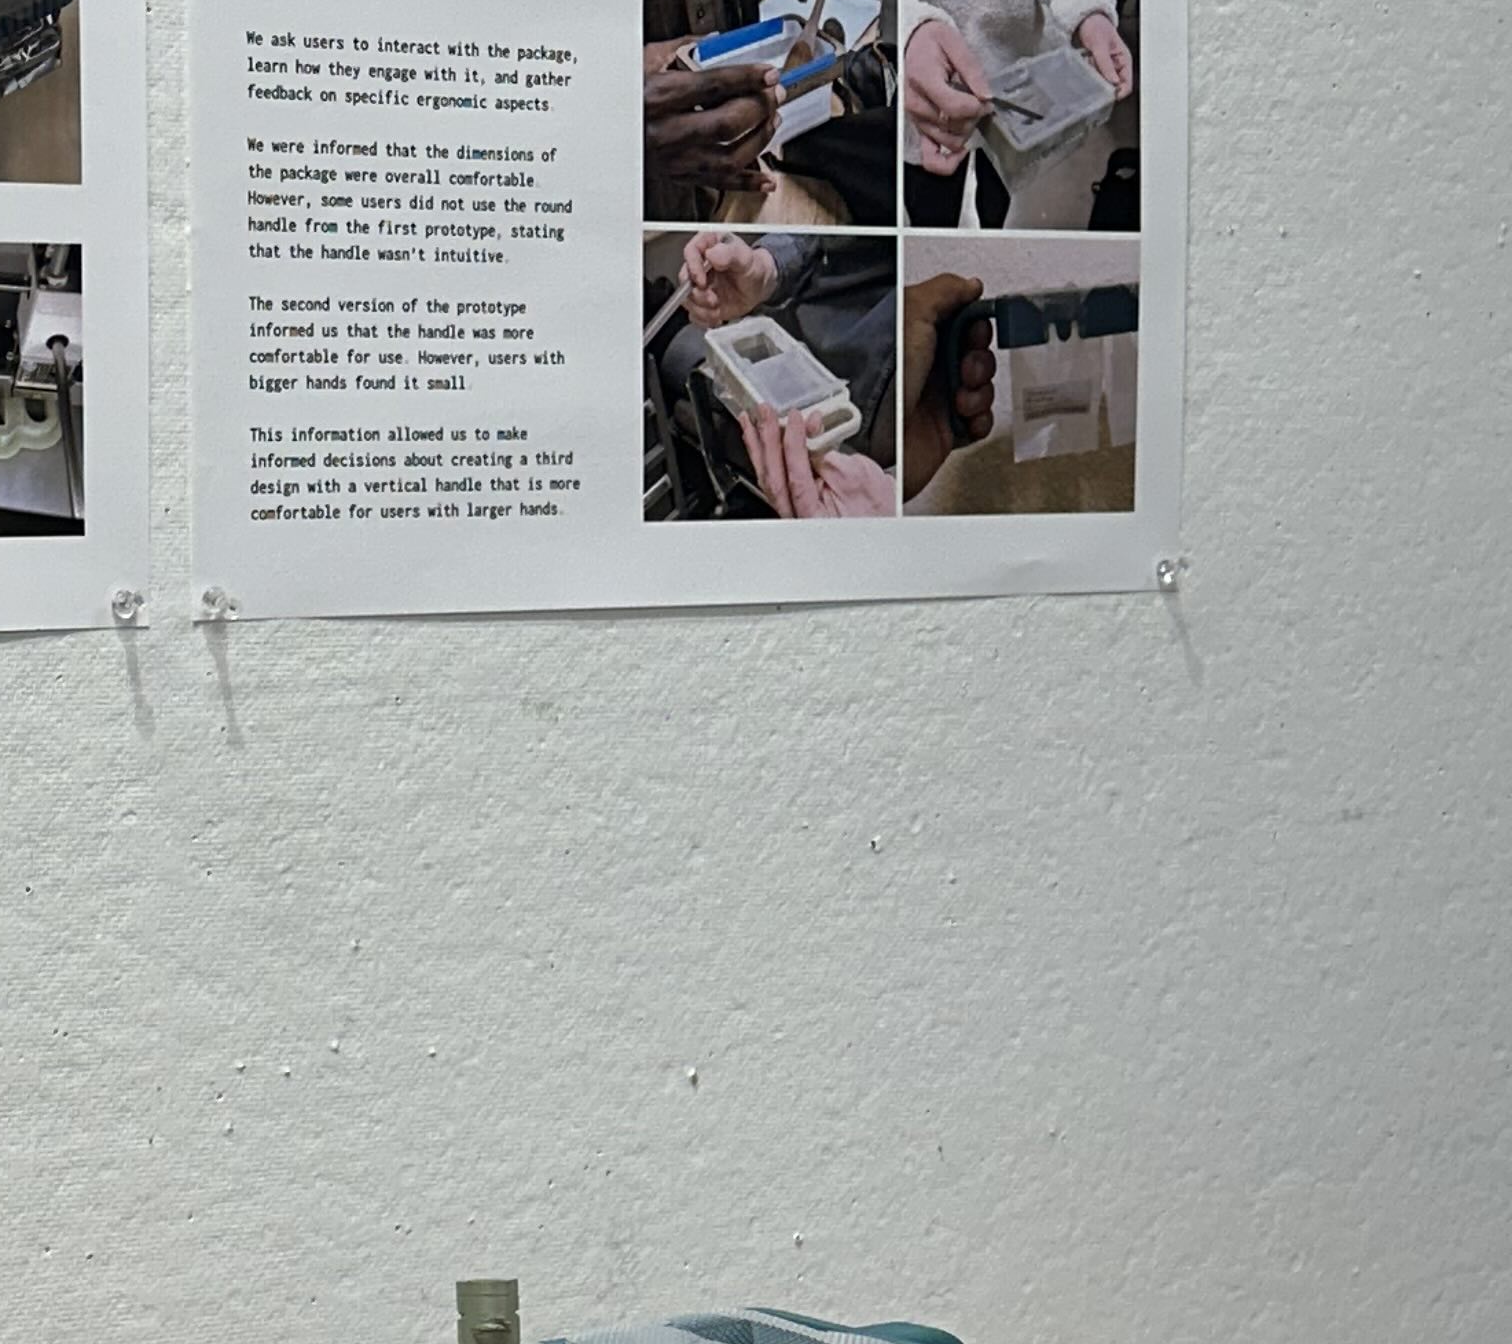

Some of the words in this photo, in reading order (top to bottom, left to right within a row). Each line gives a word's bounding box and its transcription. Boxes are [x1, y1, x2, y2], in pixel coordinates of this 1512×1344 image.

[245, 30, 264, 46] We
[270, 31, 296, 48] ask
[303, 36, 345, 50] users
[353, 36, 369, 52] to
[377, 36, 441, 56] interact
[447, 41, 480, 57] with
[487, 42, 511, 59] the
[517, 44, 578, 65] package,
[247, 56, 288, 74] learn
[295, 58, 321, 75] how
[328, 61, 361, 80] they
[368, 66, 417, 83] engage
[423, 65, 457, 82] with
[464, 67, 486, 87] it,
[494, 69, 519, 85] and
[525, 71, 572, 89] gather
[247, 83, 313, 102] feedback
[319, 90, 337, 102] on
[344, 89, 409, 107] specific
[416, 94, 488, 111] ergonomic
[247, 136, 264, 153] We
[271, 141, 305, 154] were
[313, 139, 378, 157] informed
[385, 141, 417, 158] that
[425, 143, 449, 159] the
[456, 144, 535, 162] dimensions
[541, 147, 558, 163] of
[248, 163, 273, 179] the
[280, 164, 338, 184] package
[344, 170, 378, 183] were
[385, 168, 441, 185] overall
[247, 190, 311, 210] However,
[320, 195, 354, 208] some
[361, 196, 402, 210] users
[409, 194, 434, 211] did
[441, 198, 465, 212] not
[472, 200, 496, 212] use
[503, 197, 527, 213] the
[534, 199, 573, 214] round
[248, 216, 297, 233] handle
[304, 217, 338, 234] from
[345, 218, 370, 235] the
[378, 219, 418, 236] first
[425, 223, 502, 241] prototype,
[510, 223, 565, 242] stating
[248, 242, 281, 259] that
[289, 243, 314, 259] the
[320, 243, 371, 261] handle
[377, 247, 426, 262] wasn't
[248, 295, 274, 312] The
[281, 296, 331, 312] second
[338, 297, 395, 313] version
[401, 297, 419, 313] of
[426, 298, 450, 314] the
[456, 300, 527, 318] prototype
[249, 321, 315, 338] informed
[321, 326, 339, 338] us
[346, 322, 379, 339] that
[387, 323, 411, 339] the
[417, 323, 465, 340] handle
[471, 328, 496, 340] was
[502, 328, 535, 340] more
[249, 347, 339, 364] comfortable
[346, 348, 371, 364] for
[418, 349, 480, 368] However,
[488, 353, 527, 365] users
[533, 350, 565, 365] with
[249, 374, 299, 393] bigger
[306, 374, 348, 390] hands
[355, 374, 396, 390] found
[403, 375, 420, 391] it
[249, 426, 283, 443] This
[291, 426, 381, 442] information
[387, 425, 444, 442] allowed
[450, 430, 467, 442] us
[474, 428, 490, 441] to
[496, 425, 528, 441] make
[251, 452, 316, 469] informed
[323, 451, 397, 468] decisions
[403, 451, 444, 467] about
[450, 451, 514, 470] creating
[519, 454, 528, 466] a
[535, 450, 574, 466] third
[250, 478, 300, 498] design
[306, 478, 341, 494] with
[347, 481, 357, 493] a
[364, 477, 428, 493] vertical
[435, 476, 482, 492] handle
[489, 476, 521, 492] that
[528, 476, 543, 491] is
[549, 479, 581, 491] more
[250, 503, 341, 521] comfortable
[348, 503, 373, 519] for
[380, 506, 421, 519] users
[427, 502, 460, 518] with
[467, 501, 513, 520] larger
